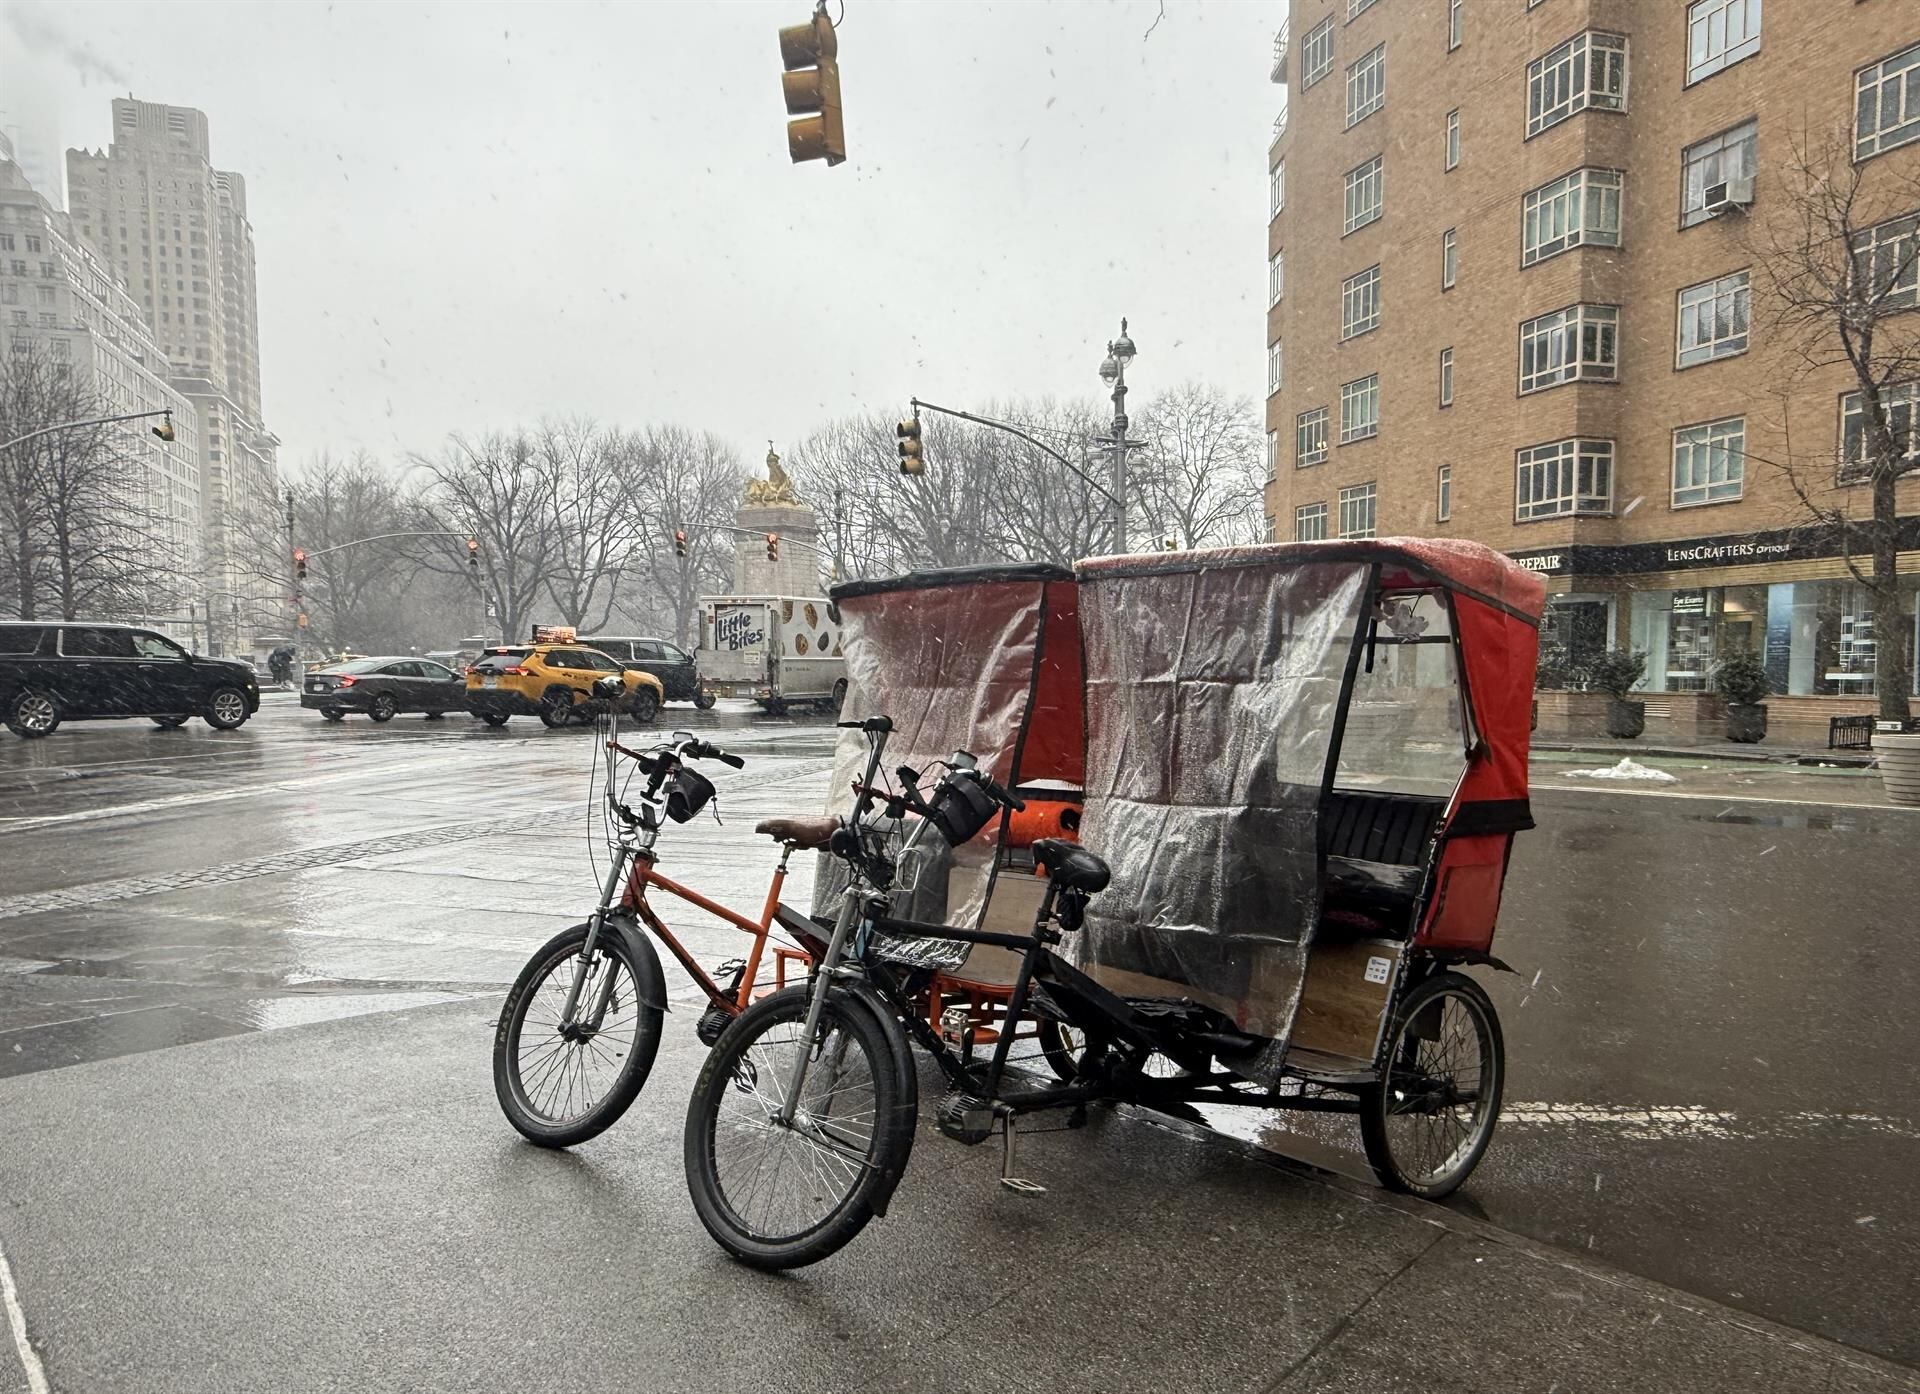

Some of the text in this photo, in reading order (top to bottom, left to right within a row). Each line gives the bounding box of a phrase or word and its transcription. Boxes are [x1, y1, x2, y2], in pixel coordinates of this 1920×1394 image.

[1667, 543, 1754, 562] LENSCRAFTERS
[1518, 555, 1561, 571] REPAIR
[718, 612, 751, 642] Little
[729, 629, 763, 651] Bites
